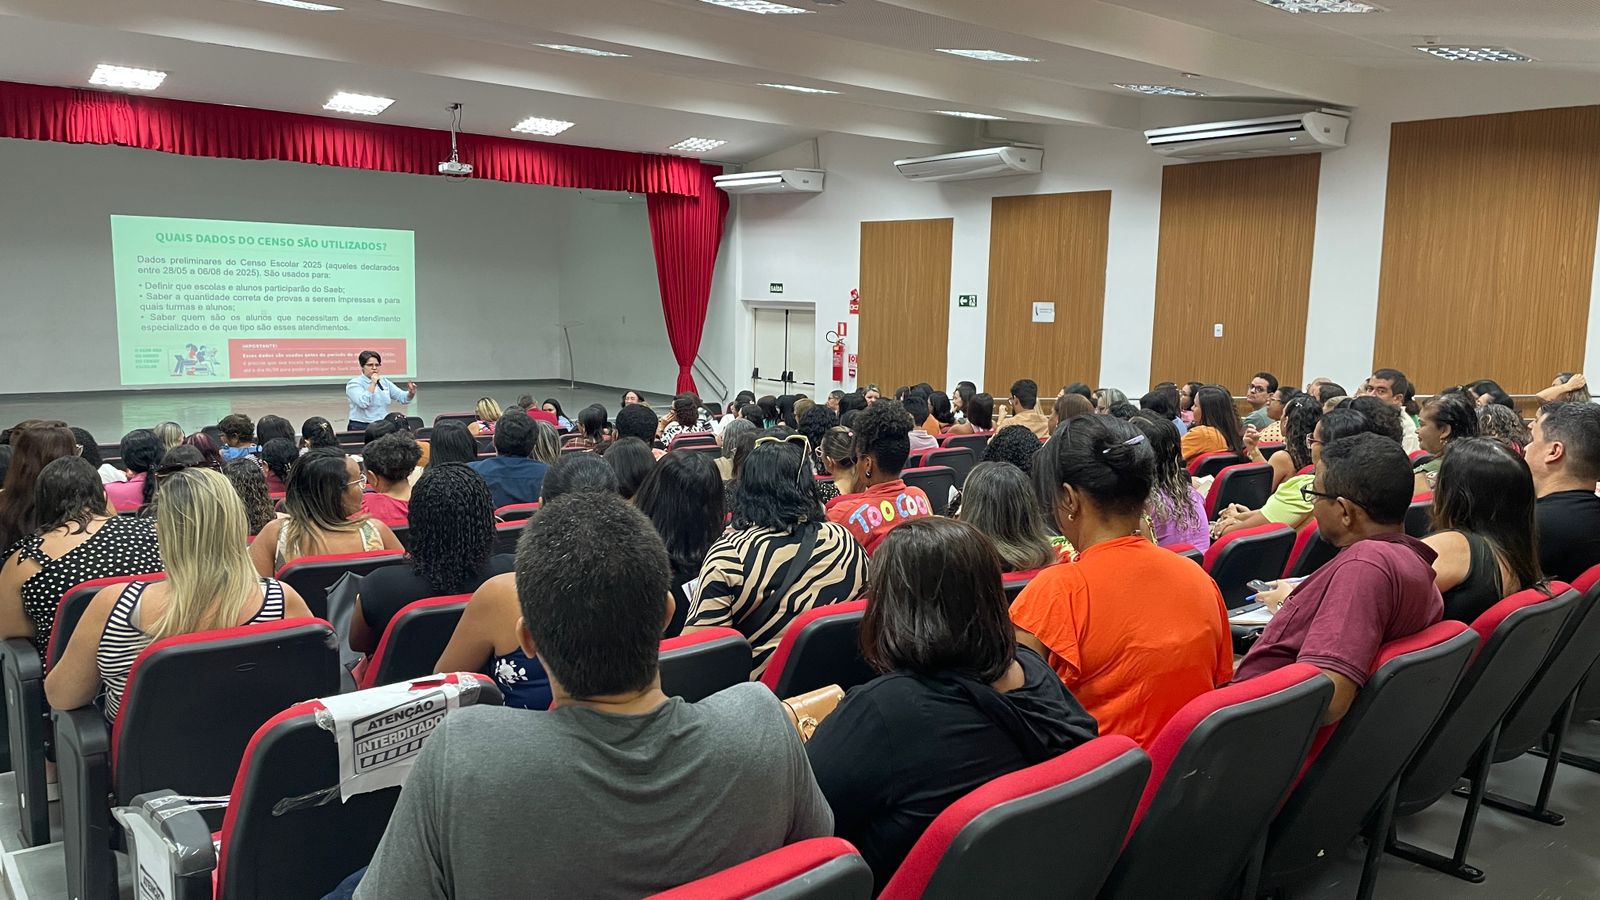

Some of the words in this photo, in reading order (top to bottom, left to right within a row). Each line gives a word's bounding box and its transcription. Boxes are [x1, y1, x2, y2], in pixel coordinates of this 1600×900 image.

[155, 232, 193, 243] QUAIS
[196, 234, 236, 244] DADOS
[238, 236, 255, 246] DO
[258, 236, 294, 247] CENSO
[297, 237, 318, 248] SÃO
[321, 240, 387, 251] UTILIZADOS?
[137, 255, 166, 264] Dados
[170, 256, 222, 266] preliminares
[226, 258, 236, 266] do
[240, 258, 266, 267] Censo
[270, 260, 299, 268] Escolar
[325, 262, 358, 271] (aqueles
[360, 263, 400, 272] declarados
[162, 266, 188, 274] 28/05
[223, 268, 234, 276] de
[264, 269, 280, 277] São
[282, 270, 310, 278] usados
[144, 282, 173, 290] Definir
[176, 283, 192, 292] que
[194, 282, 226, 291] escolas
[264, 284, 310, 293] participarão
[146, 292, 173, 300] Saber
[184, 293, 230, 302] quantidade
[338, 296, 376, 304] impressas
[140, 304, 164, 312] quais
[141, 324, 199, 332] especializado
[368, 700, 434, 731] ATENÇÃO
[358, 715, 444, 755] INTERDITADO
